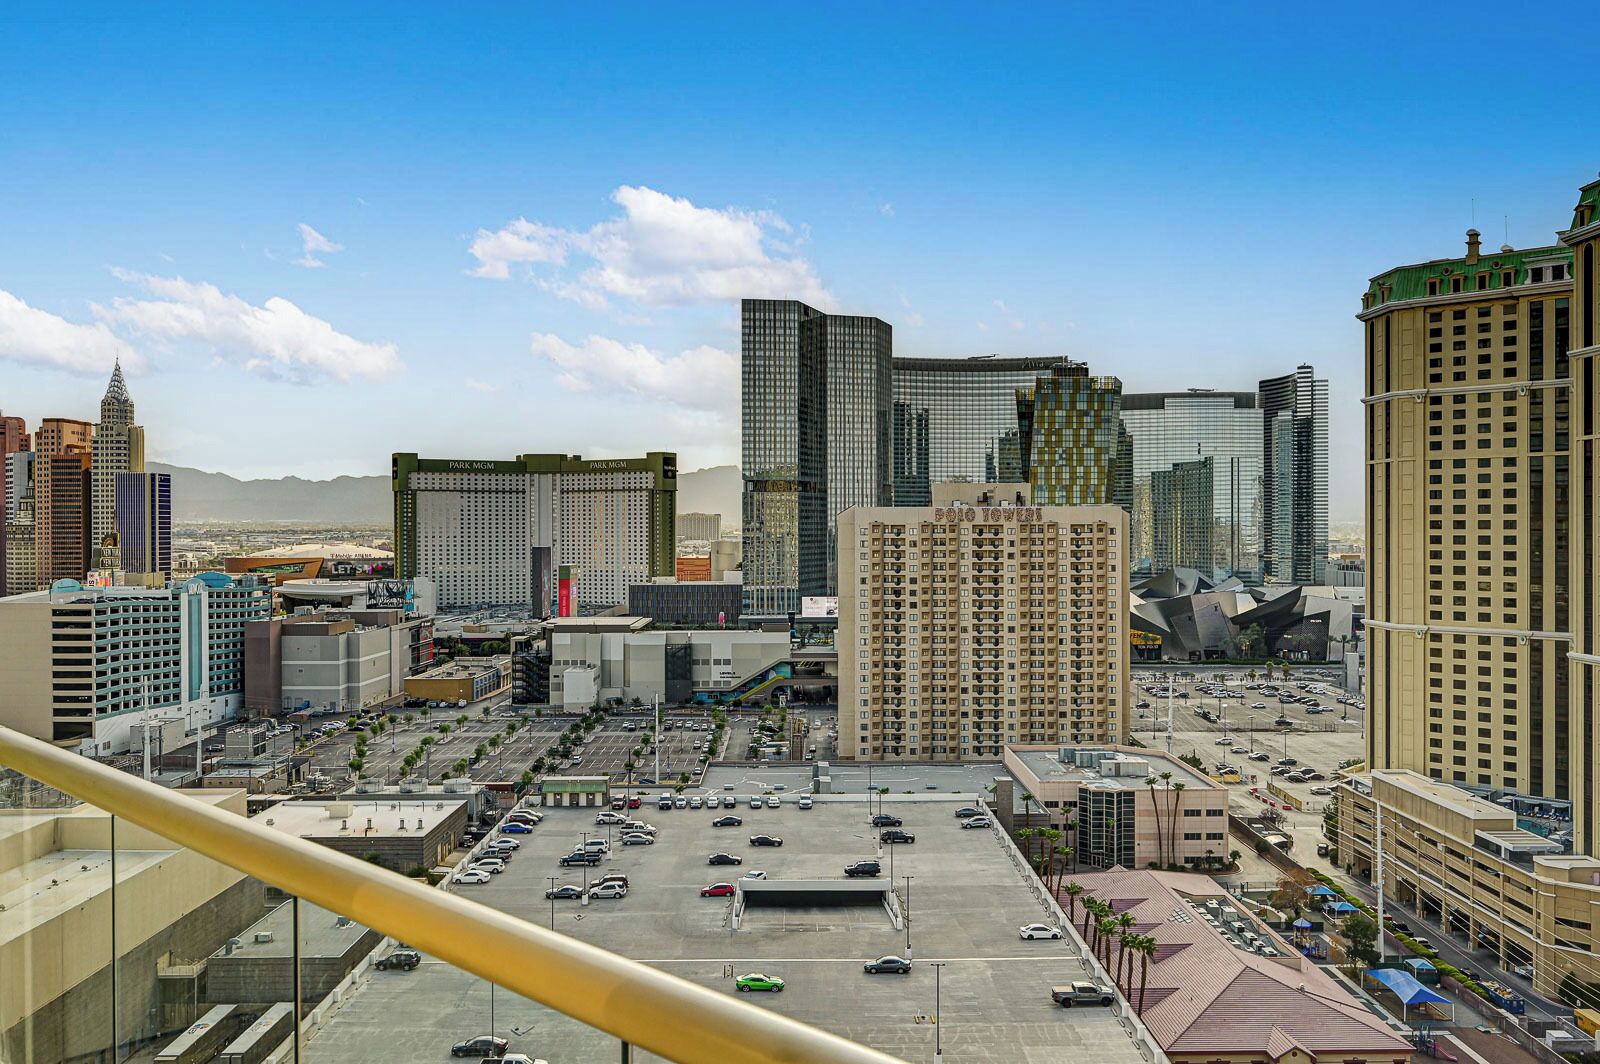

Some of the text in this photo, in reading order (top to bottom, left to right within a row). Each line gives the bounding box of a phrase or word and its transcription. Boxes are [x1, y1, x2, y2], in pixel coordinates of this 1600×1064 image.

[472, 462, 495, 470] MGM
[935, 507, 1042, 522] POLO TOWERS
